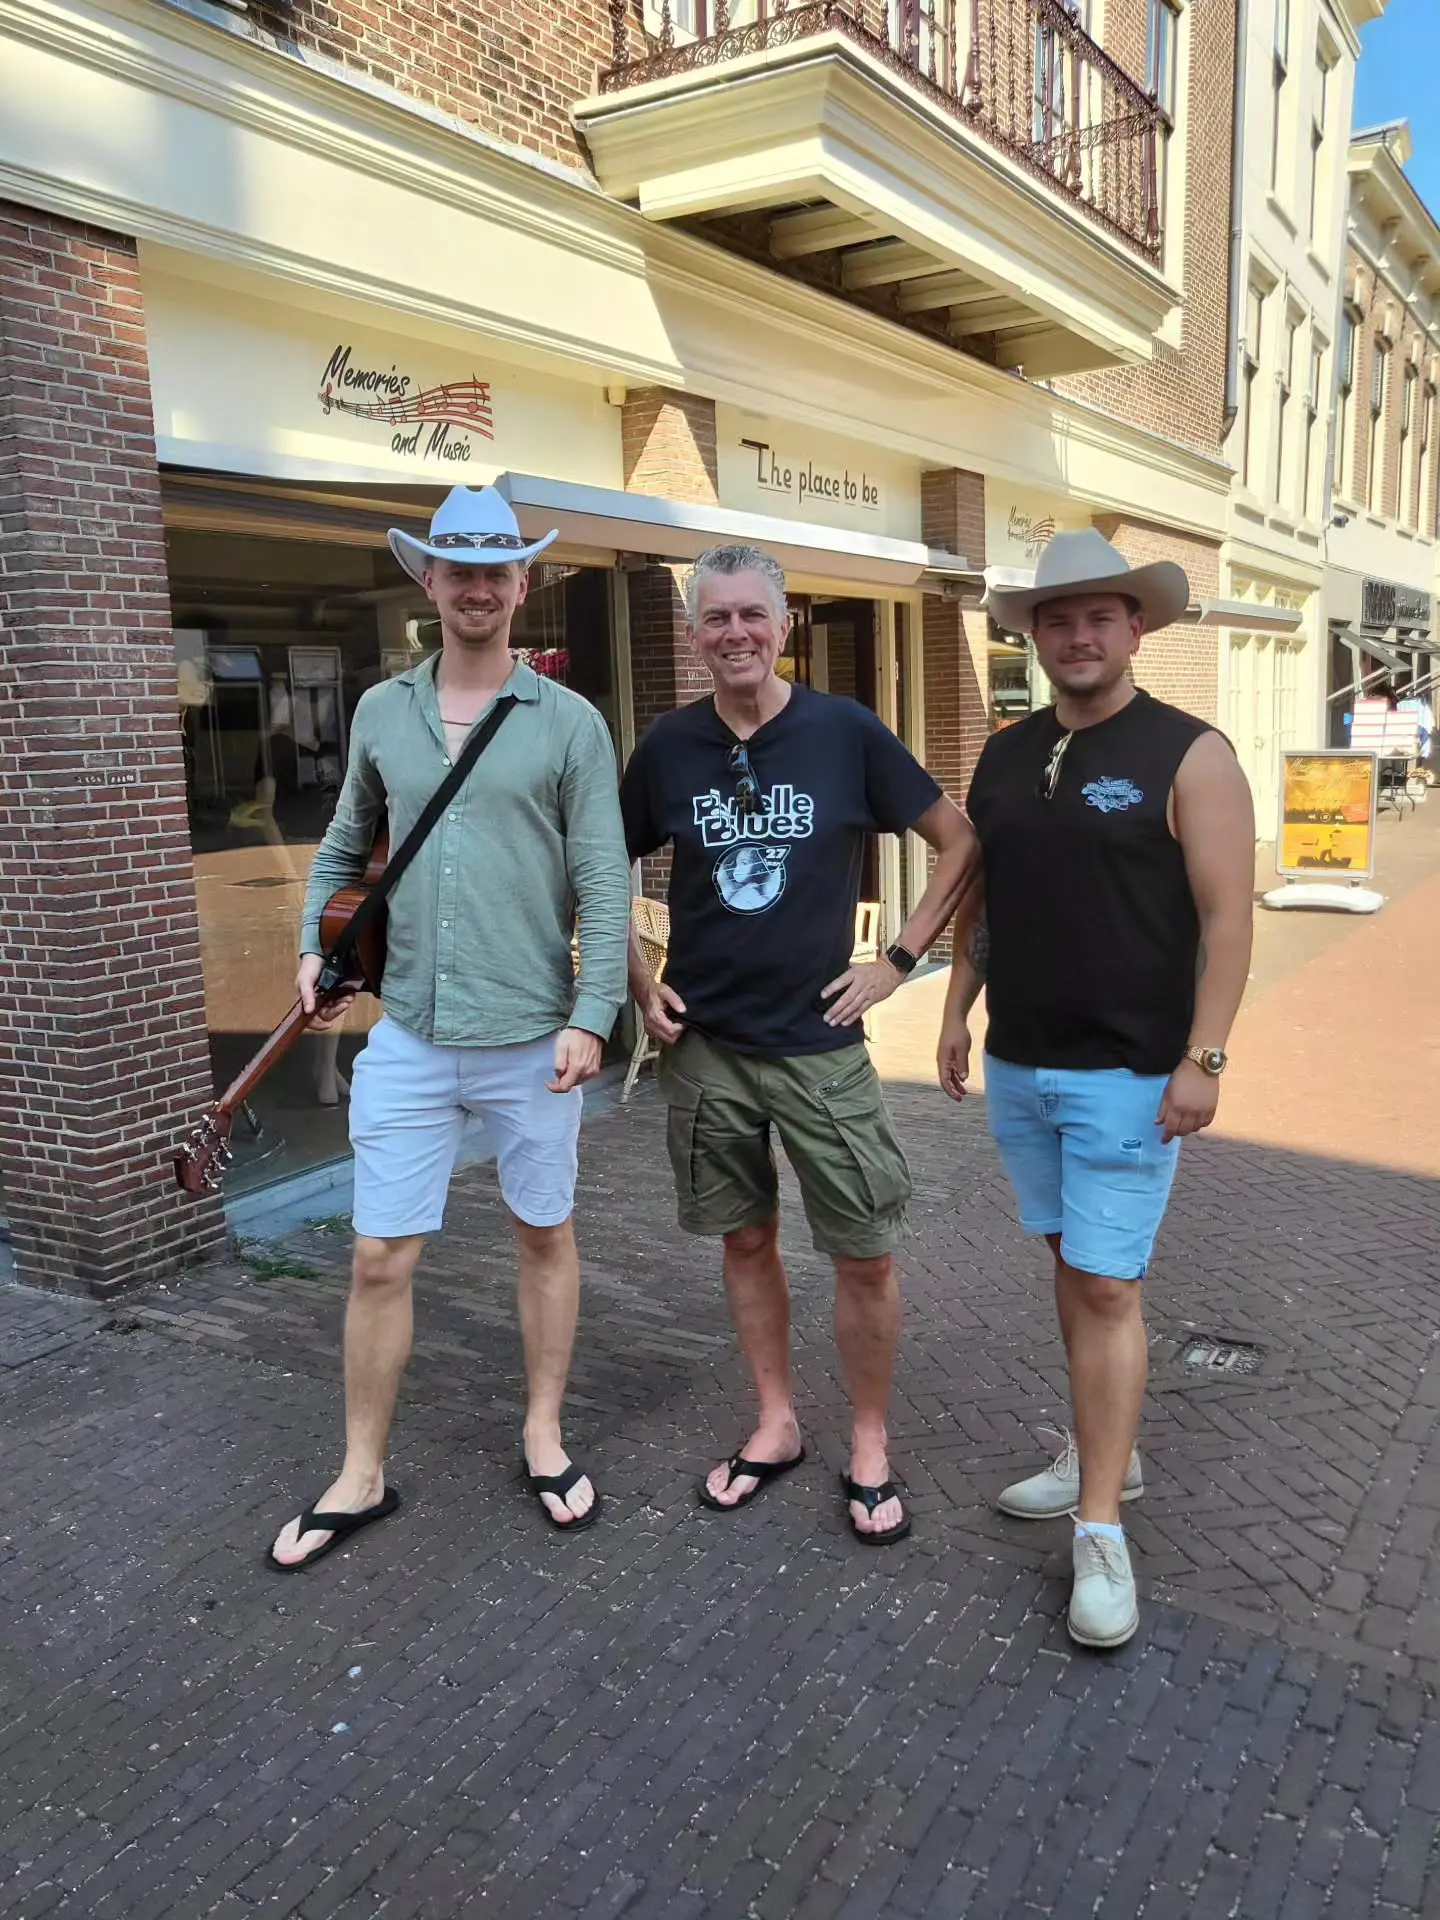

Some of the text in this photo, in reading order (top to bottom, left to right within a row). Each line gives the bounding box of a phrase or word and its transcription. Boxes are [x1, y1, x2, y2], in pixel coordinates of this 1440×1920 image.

[320, 344, 411, 397] Memories
[391, 422, 471, 461] and Music
[739, 438, 878, 505] The place to be
[701, 813, 814, 847] Blues
[765, 848, 787, 859] 27
